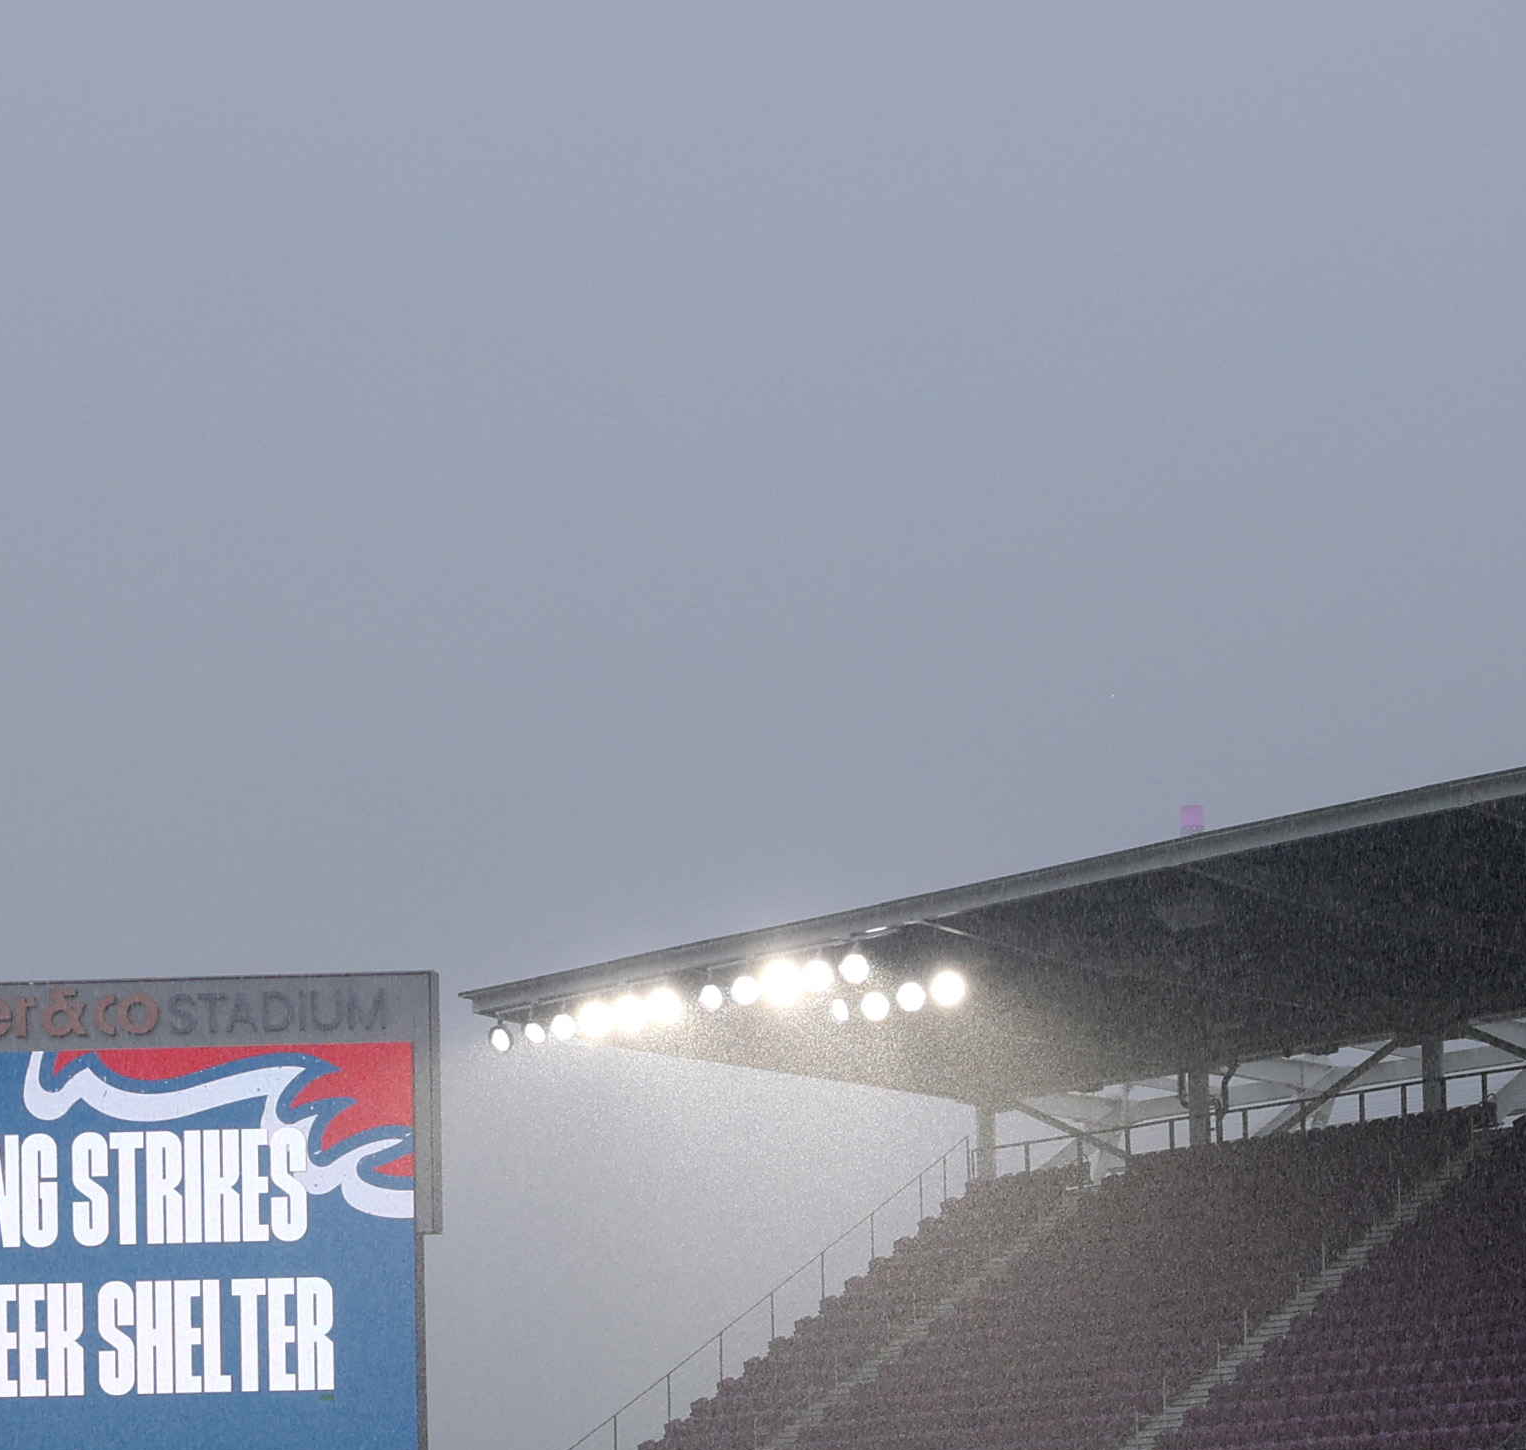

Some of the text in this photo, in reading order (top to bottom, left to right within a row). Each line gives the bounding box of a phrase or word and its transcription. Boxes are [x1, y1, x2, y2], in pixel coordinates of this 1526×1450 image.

[171, 988, 388, 1038] STADIUM
[72, 1127, 308, 1248] STRIKES
[97, 1276, 335, 1397] SHELTER
